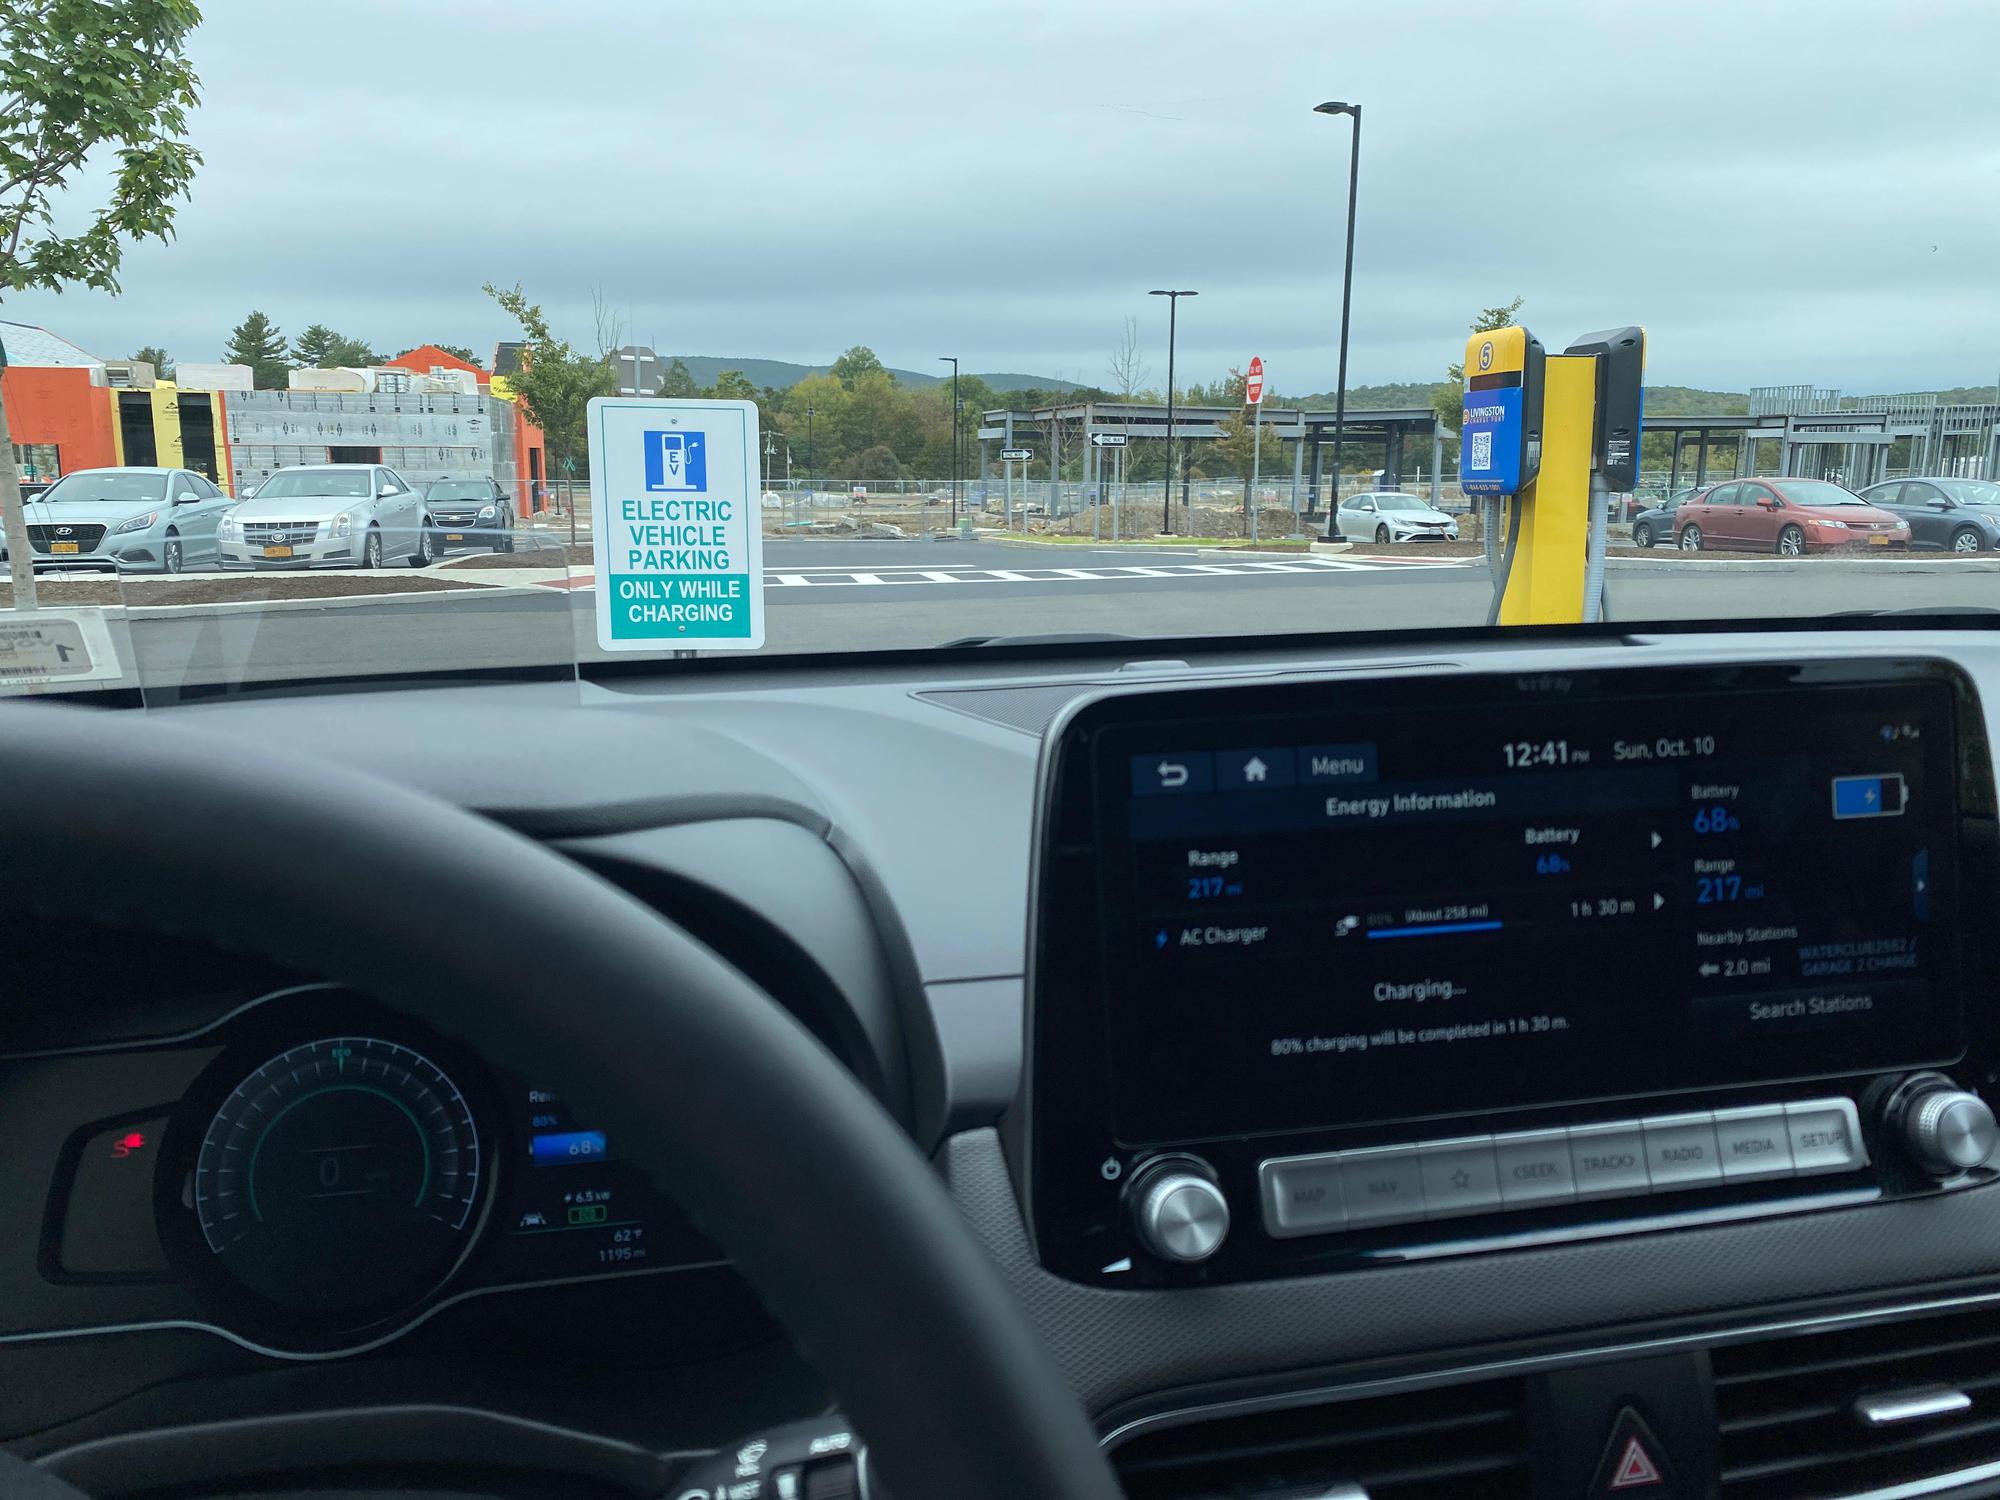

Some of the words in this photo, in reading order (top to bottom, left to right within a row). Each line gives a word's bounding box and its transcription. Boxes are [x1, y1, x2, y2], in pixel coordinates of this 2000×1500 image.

[1470, 406, 1505, 418] LIVINGSTON
[622, 500, 733, 521] ELECTRIC
[629, 525, 727, 546] VEHICLE
[629, 550, 731, 570] PARKING
[619, 581, 674, 600] ONLY
[678, 580, 742, 599] WHILE
[628, 603, 734, 623] CHARGING
[1503, 739, 1569, 768] 12:41
[1571, 750, 1591, 764] PM
[1693, 735, 1716, 756] 10
[1311, 755, 1365, 778] Menu
[1690, 784, 1741, 800] Battery
[1326, 797, 1391, 818] Energy
[1393, 788, 1497, 813] Information
[1524, 827, 1581, 846] Battery
[1187, 850, 1240, 869] Range
[1693, 858, 1736, 875] Range
[1187, 876, 1225, 899] 217
[1696, 875, 1743, 905] 217
[1598, 898, 1619, 917] 30
[1178, 927, 1203, 947] AC
[1203, 925, 1270, 946] Charger
[1696, 928, 1744, 946] Nearby
[1745, 926, 1799, 943] Stations
[1723, 958, 1749, 977] 2.0
[1750, 955, 1771, 975] mi
[1750, 998, 1806, 1021] Search
[1807, 993, 1873, 1015] Stations
[1270, 1037, 1304, 1056] 80%
[1305, 1032, 1368, 1053] charging
[1369, 1029, 1396, 1046] will
[1397, 1027, 1417, 1045] be
[1417, 1020, 1491, 1043] completed
[1492, 1018, 1507, 1035] in
[1518, 1016, 1529, 1033] h
[1530, 1015, 1550, 1032] 30
[1732, 1137, 1776, 1156] MEDIA
[1800, 1129, 1846, 1150] SETUP
[1661, 1146, 1704, 1162] RADIO
[320, 1157, 340, 1187] 0
